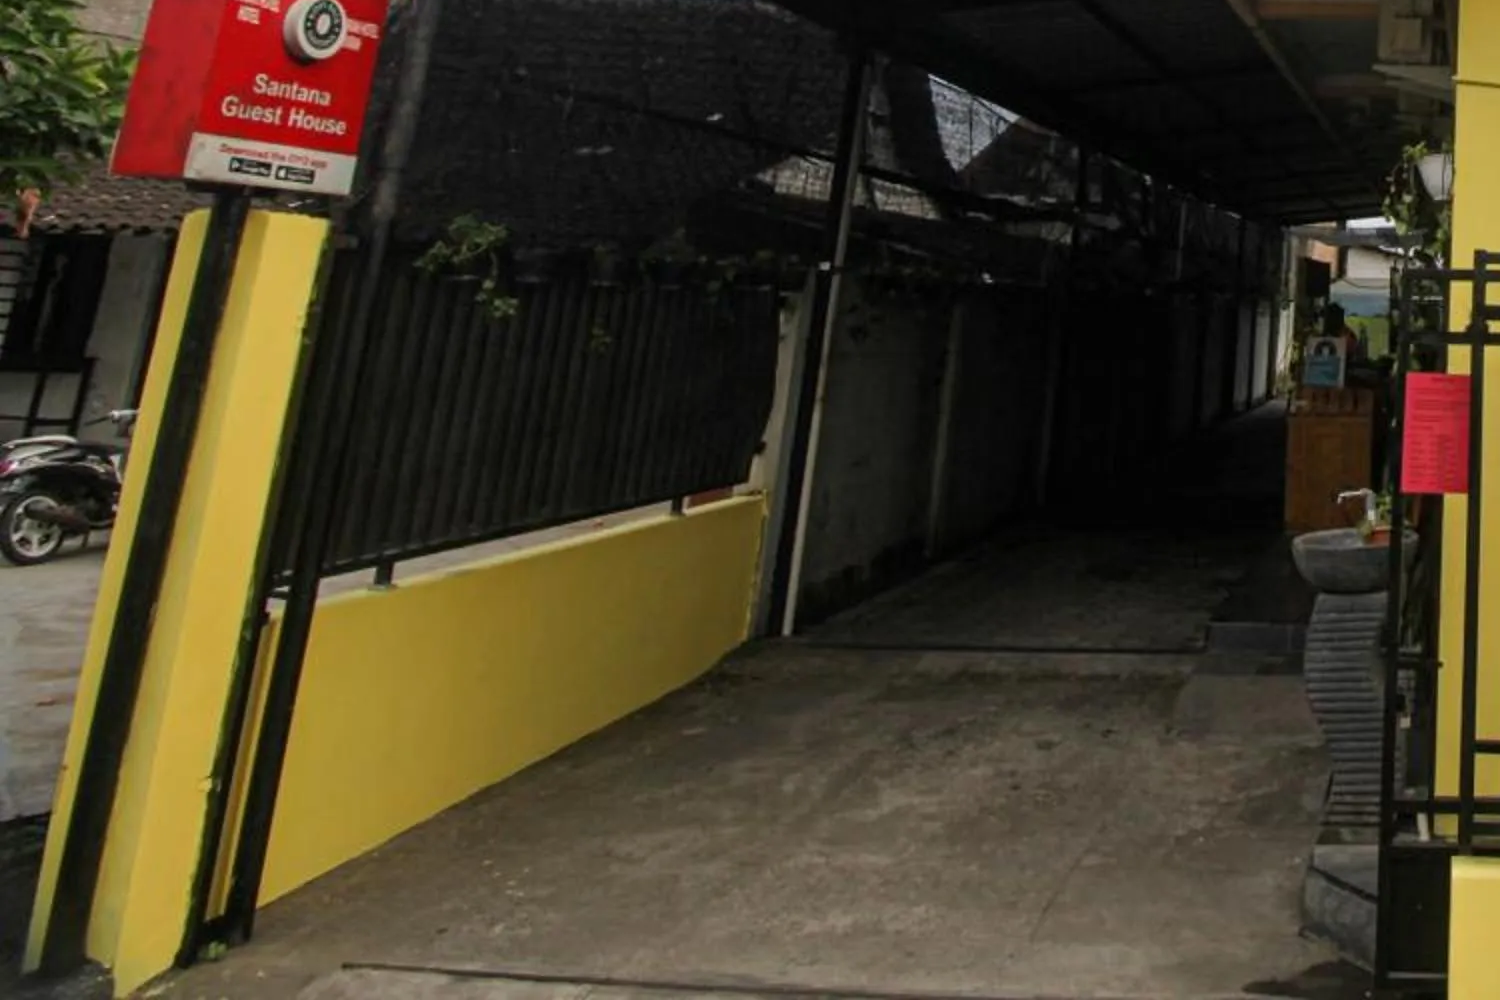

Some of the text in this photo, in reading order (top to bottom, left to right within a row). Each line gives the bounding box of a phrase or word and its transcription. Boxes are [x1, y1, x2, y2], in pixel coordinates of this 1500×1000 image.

[253, 73, 331, 106] Santana
[221, 96, 347, 135] Guest House
